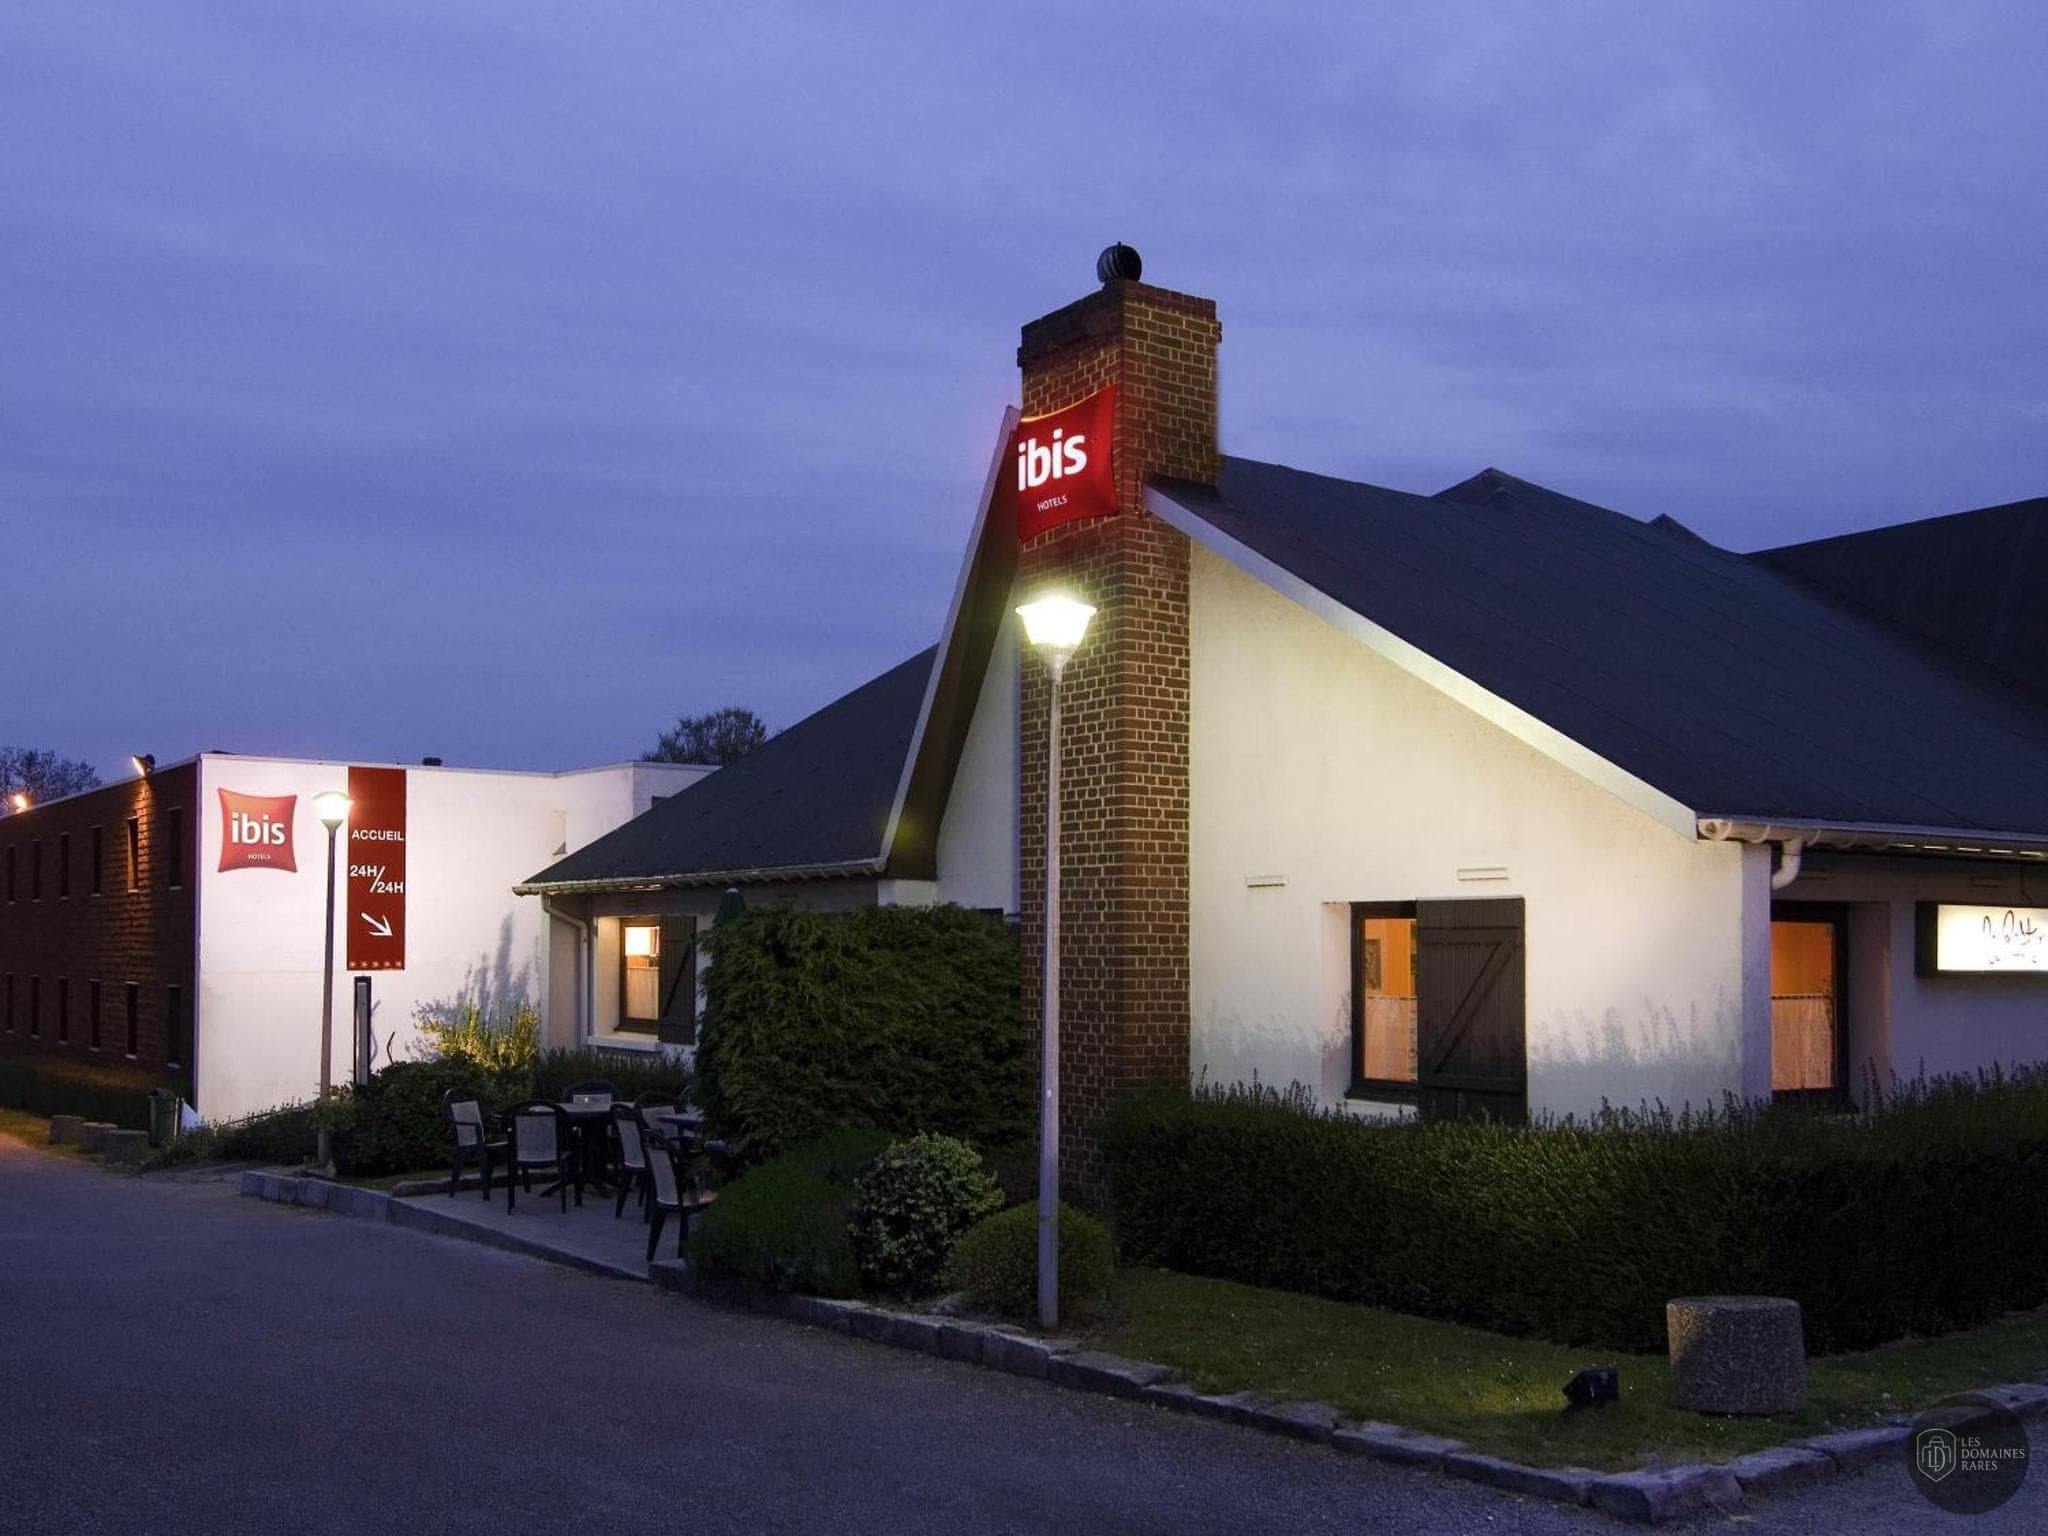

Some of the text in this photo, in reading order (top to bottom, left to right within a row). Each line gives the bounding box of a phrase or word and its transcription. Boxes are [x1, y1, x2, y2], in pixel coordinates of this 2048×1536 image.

[1018, 428, 1087, 491] ibis
[1037, 494, 1067, 511] HOTELS
[231, 811, 285, 845] ibis
[351, 829, 404, 841] ACCUEIL
